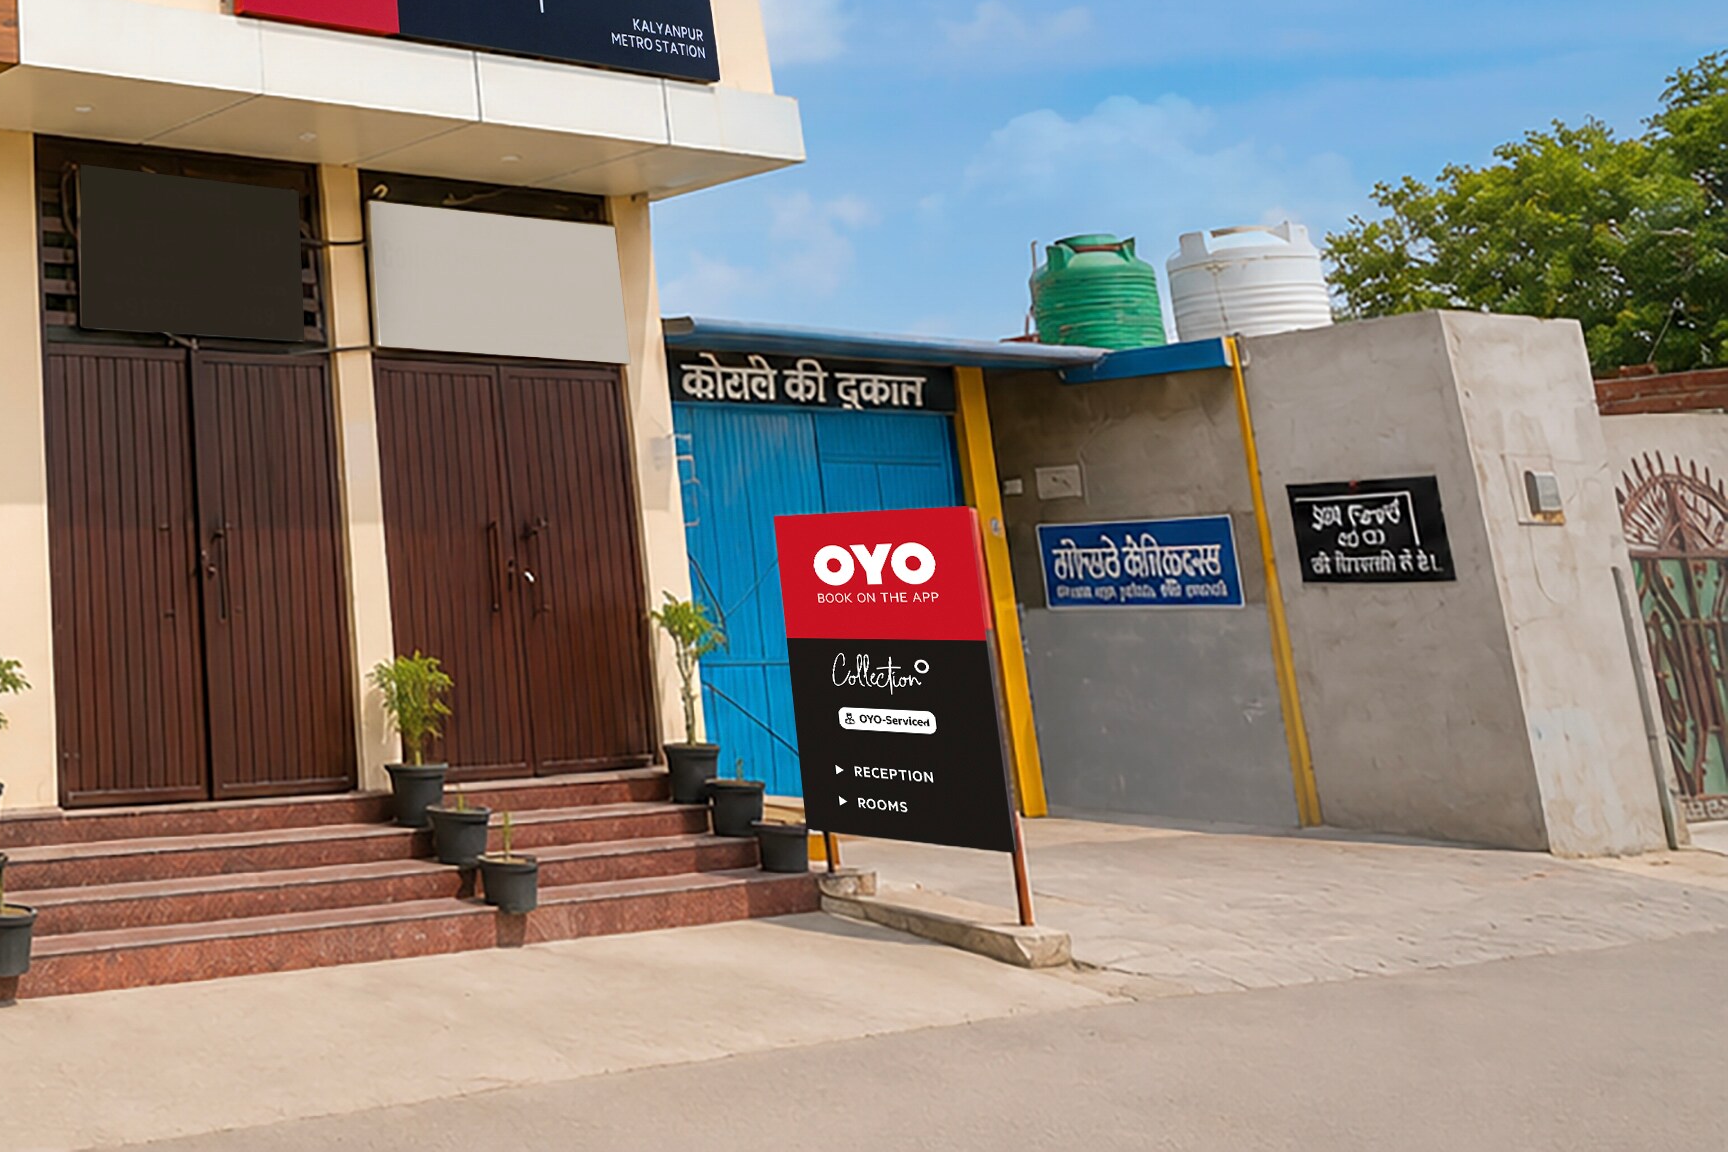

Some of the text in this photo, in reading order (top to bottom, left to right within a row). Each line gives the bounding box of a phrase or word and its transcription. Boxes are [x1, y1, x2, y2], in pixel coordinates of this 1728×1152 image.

[632, 18, 704, 42] KALYANPUR
[611, 32, 706, 59] METRO STATION
[782, 358, 828, 403] की
[813, 542, 936, 586] OYO
[817, 591, 939, 604] BOOK ON THE APP
[832, 652, 922, 695] Collection
[859, 714, 930, 727] OYO-Serviced
[854, 766, 934, 783] RECEPTION
[857, 797, 908, 813] ROOMS
